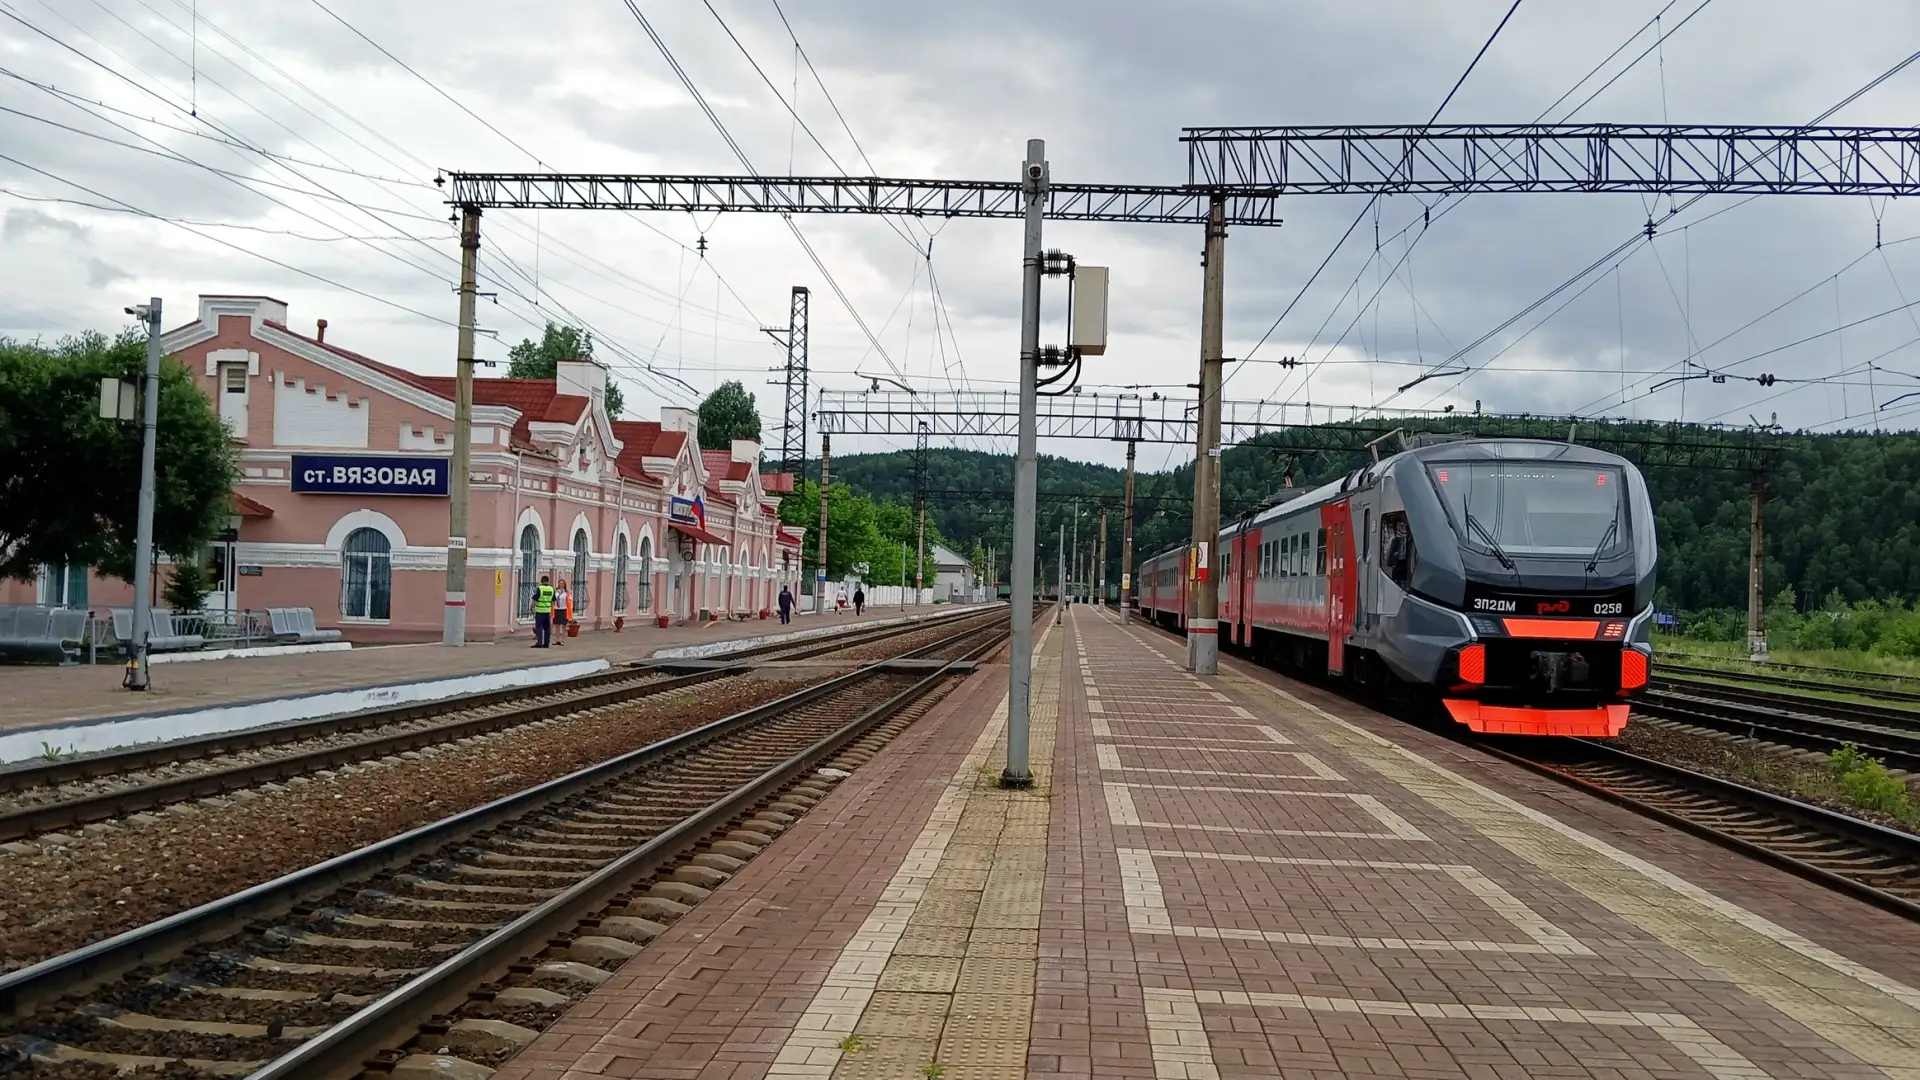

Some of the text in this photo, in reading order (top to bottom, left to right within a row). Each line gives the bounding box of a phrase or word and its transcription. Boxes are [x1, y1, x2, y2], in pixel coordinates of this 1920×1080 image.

[303, 466, 436, 486] ст.ВЯЗОВАЯ
[1473, 598, 1517, 612] ЭП2ДМ
[1593, 603, 1623, 614] 0258
